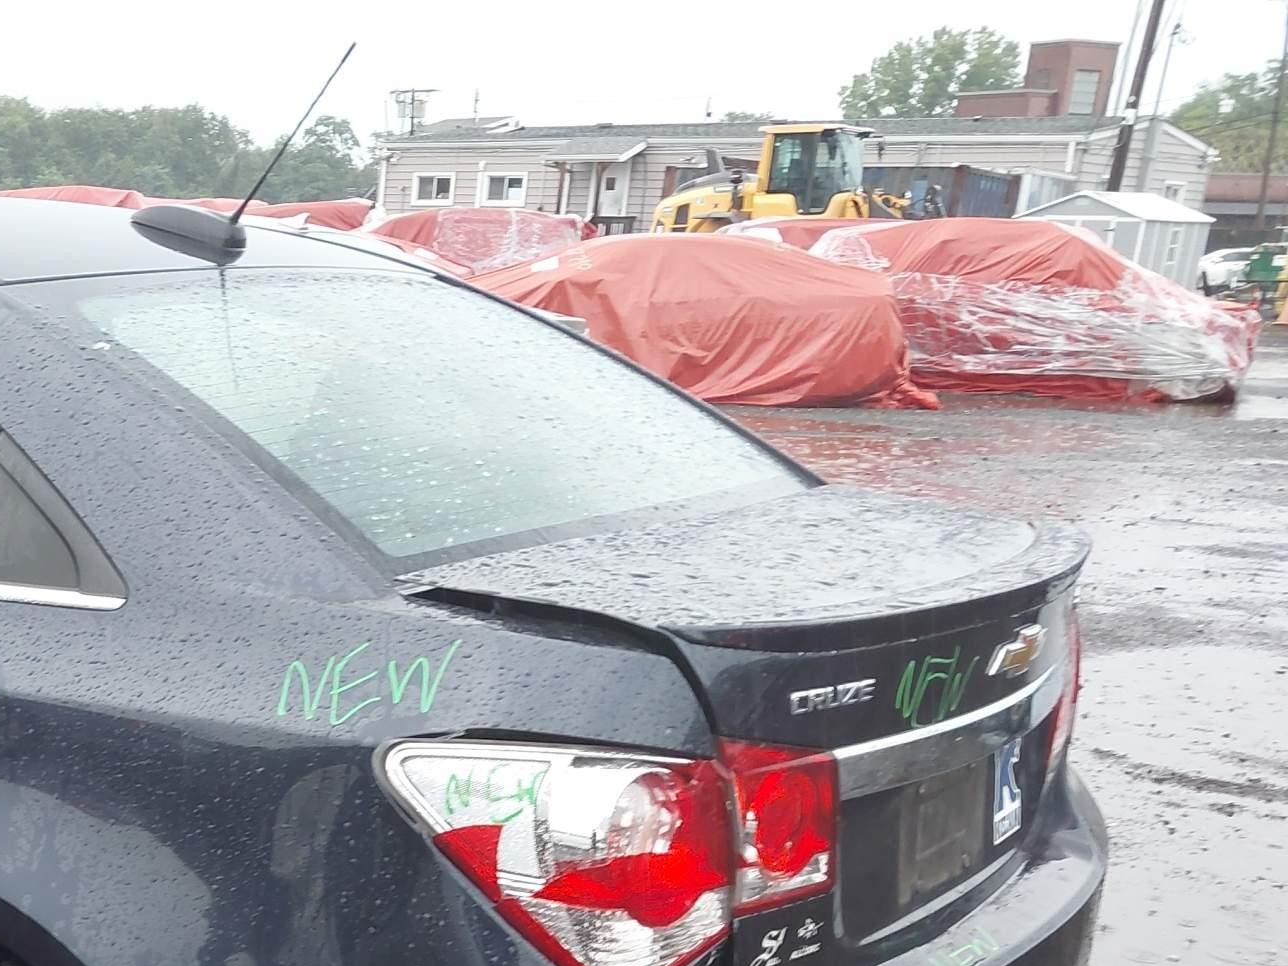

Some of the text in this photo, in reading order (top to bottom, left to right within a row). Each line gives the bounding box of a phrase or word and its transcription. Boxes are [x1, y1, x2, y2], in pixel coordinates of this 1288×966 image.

[277, 640, 461, 725] NEW
[790, 677, 877, 715] CRUZE
[895, 645, 981, 729] NEW
